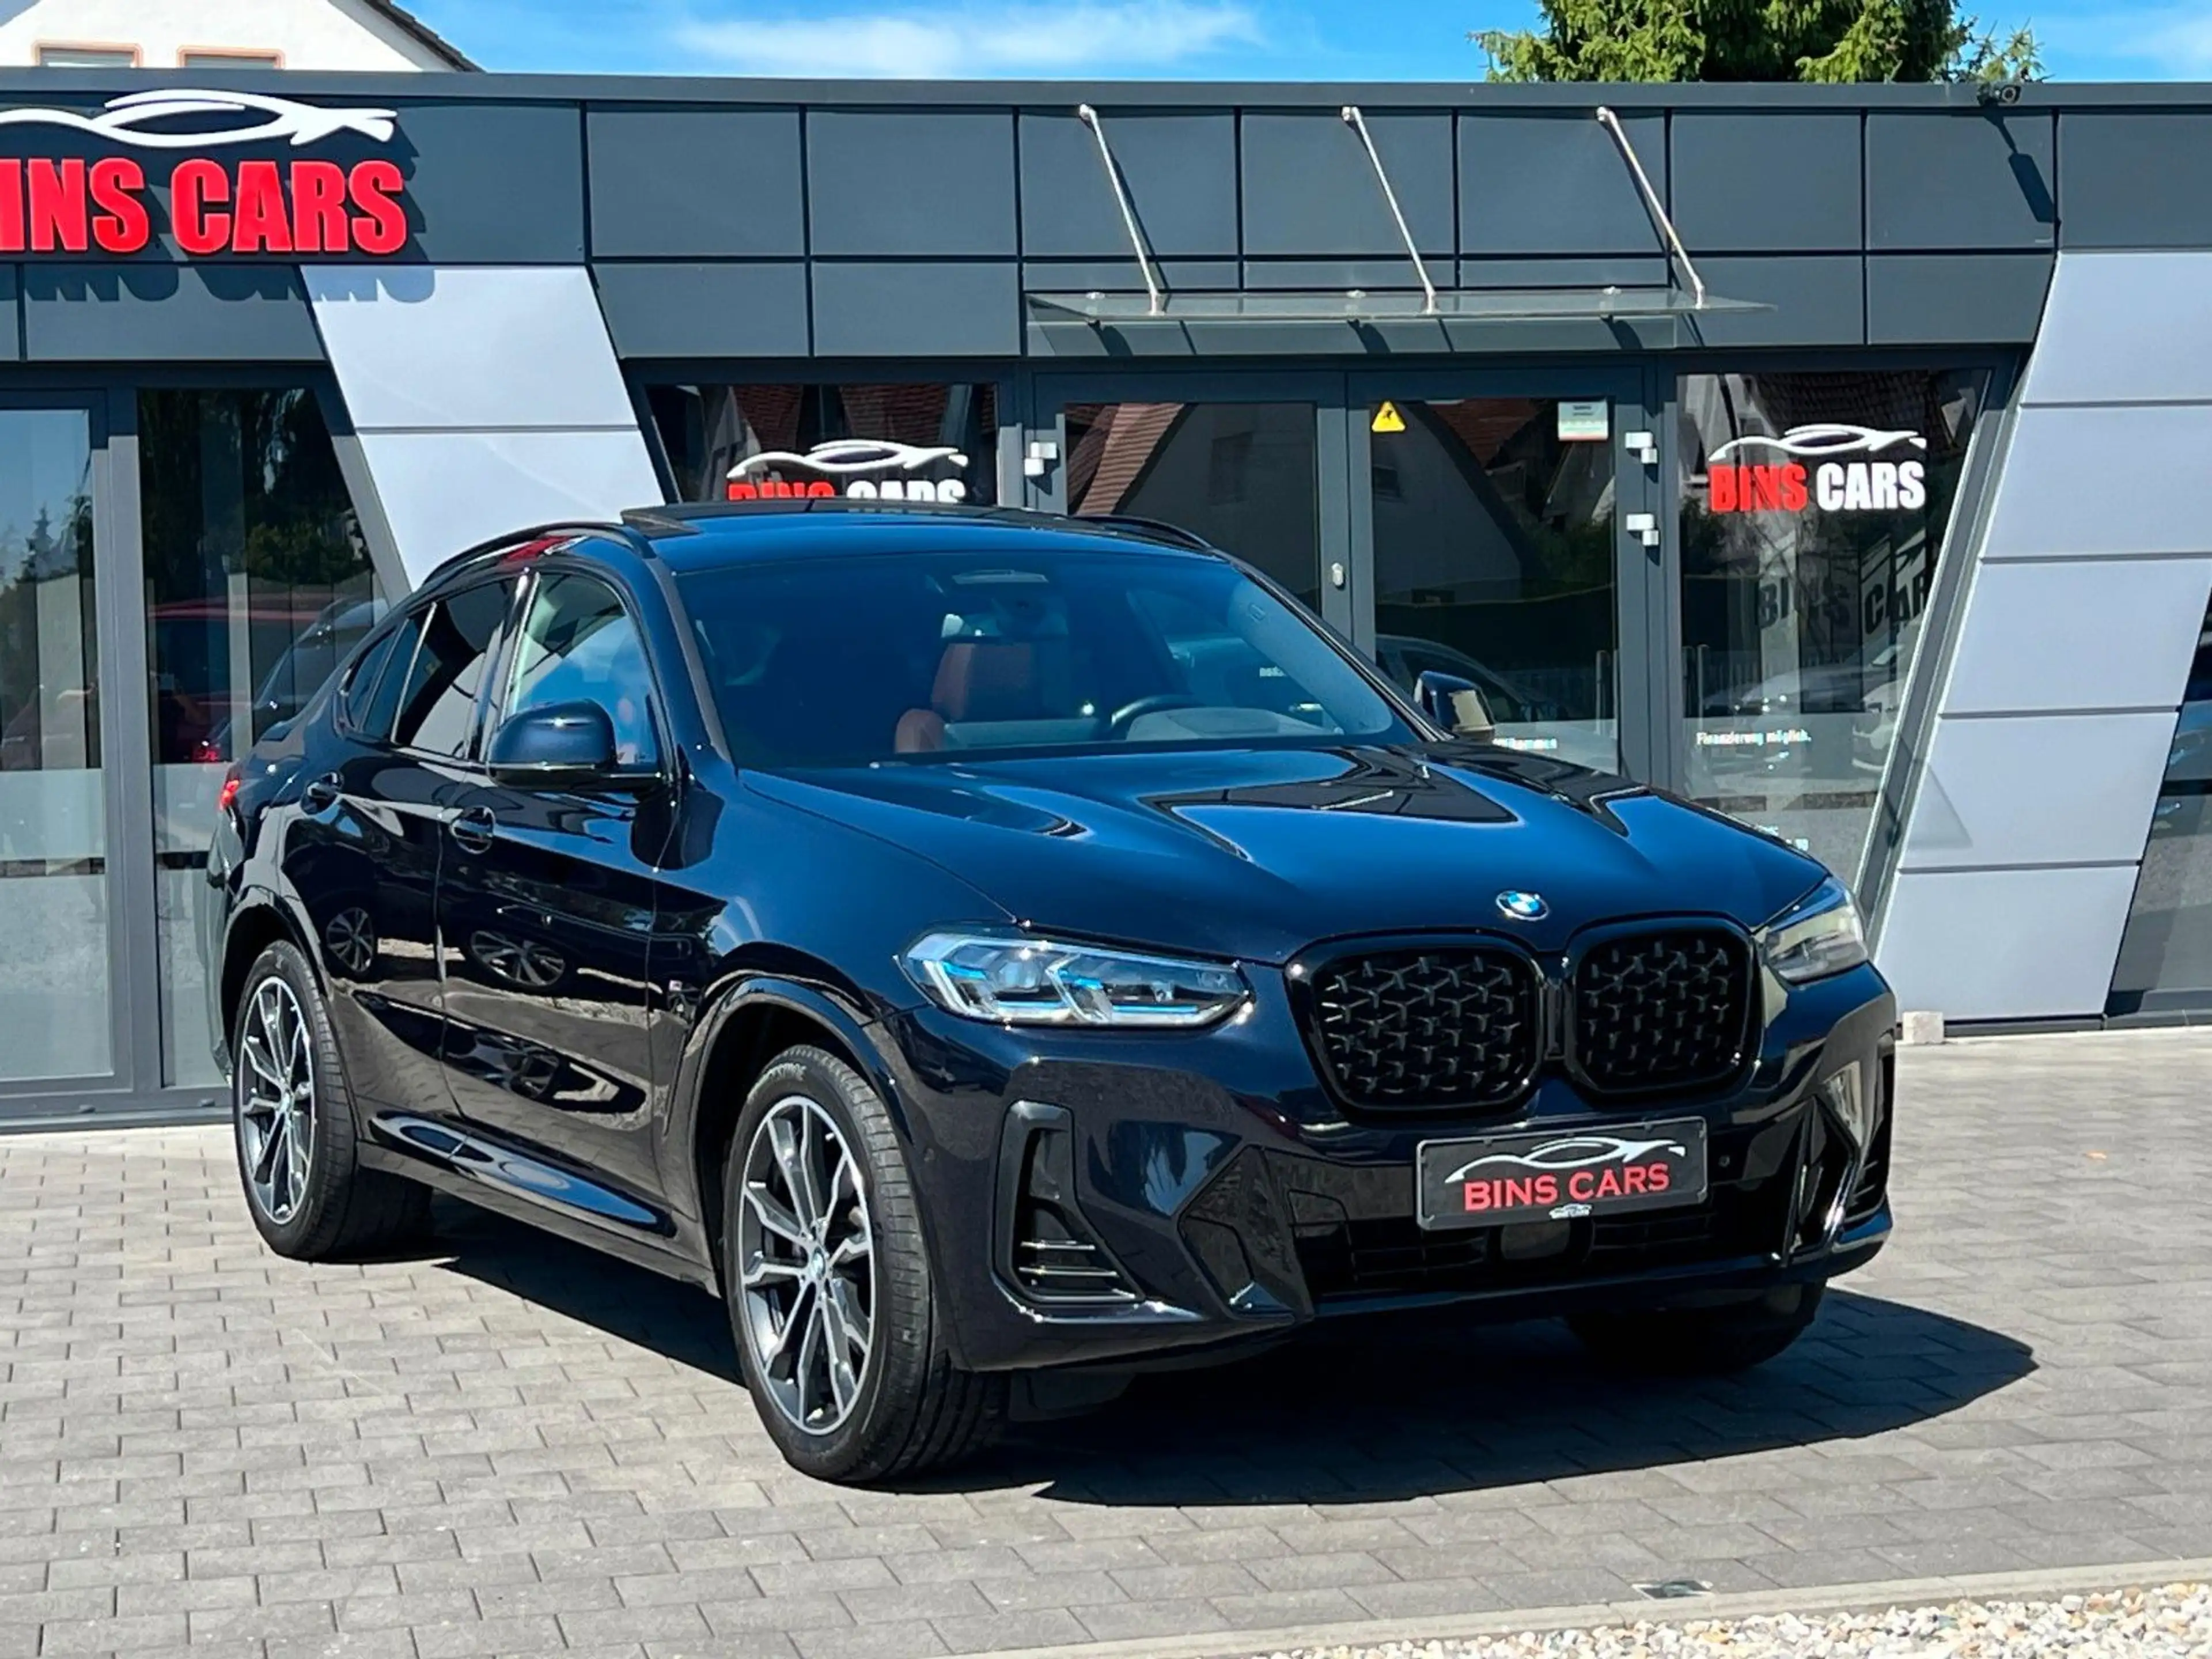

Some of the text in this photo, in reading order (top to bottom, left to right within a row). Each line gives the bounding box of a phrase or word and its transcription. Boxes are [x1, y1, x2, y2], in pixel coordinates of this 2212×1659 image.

[0, 157, 407, 254] INS CARS
[1708, 461, 1926, 513] BINS CARS
[1464, 1162, 1670, 1211] BINS CARS
